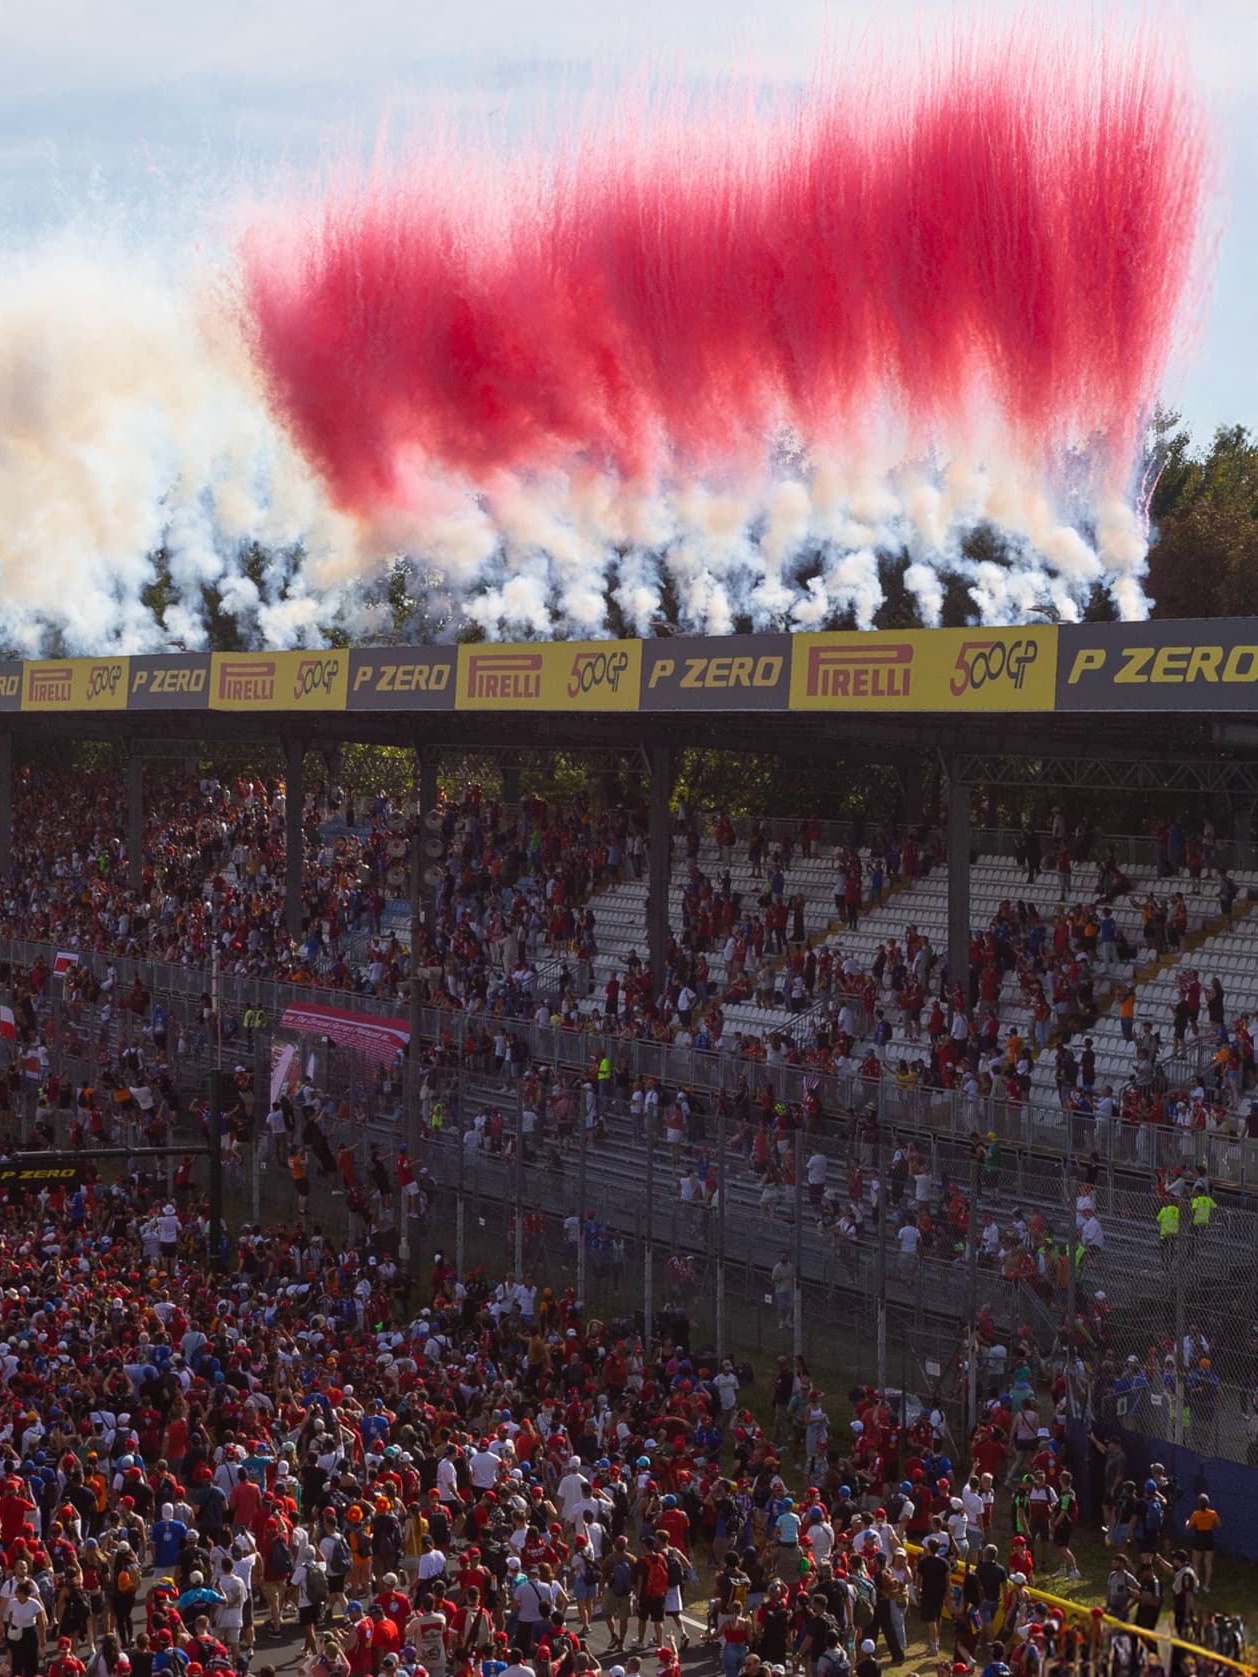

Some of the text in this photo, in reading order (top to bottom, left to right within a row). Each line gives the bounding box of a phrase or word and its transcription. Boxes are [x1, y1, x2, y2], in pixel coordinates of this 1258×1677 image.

[132, 669, 206, 693] P ZERO
[219, 660, 338, 700] PIRELLI 500GP
[353, 664, 451, 692] P ZERO
[467, 652, 629, 699] PIRELLI 500GP
[648, 656, 784, 688] P ZERO
[806, 640, 1038, 696] PIRELLI 500GP
[1068, 645, 1258, 684] P ZERO
[29, 665, 122, 702] PIRELLI 500GP
[0, 1168, 77, 1180] P ZERO
